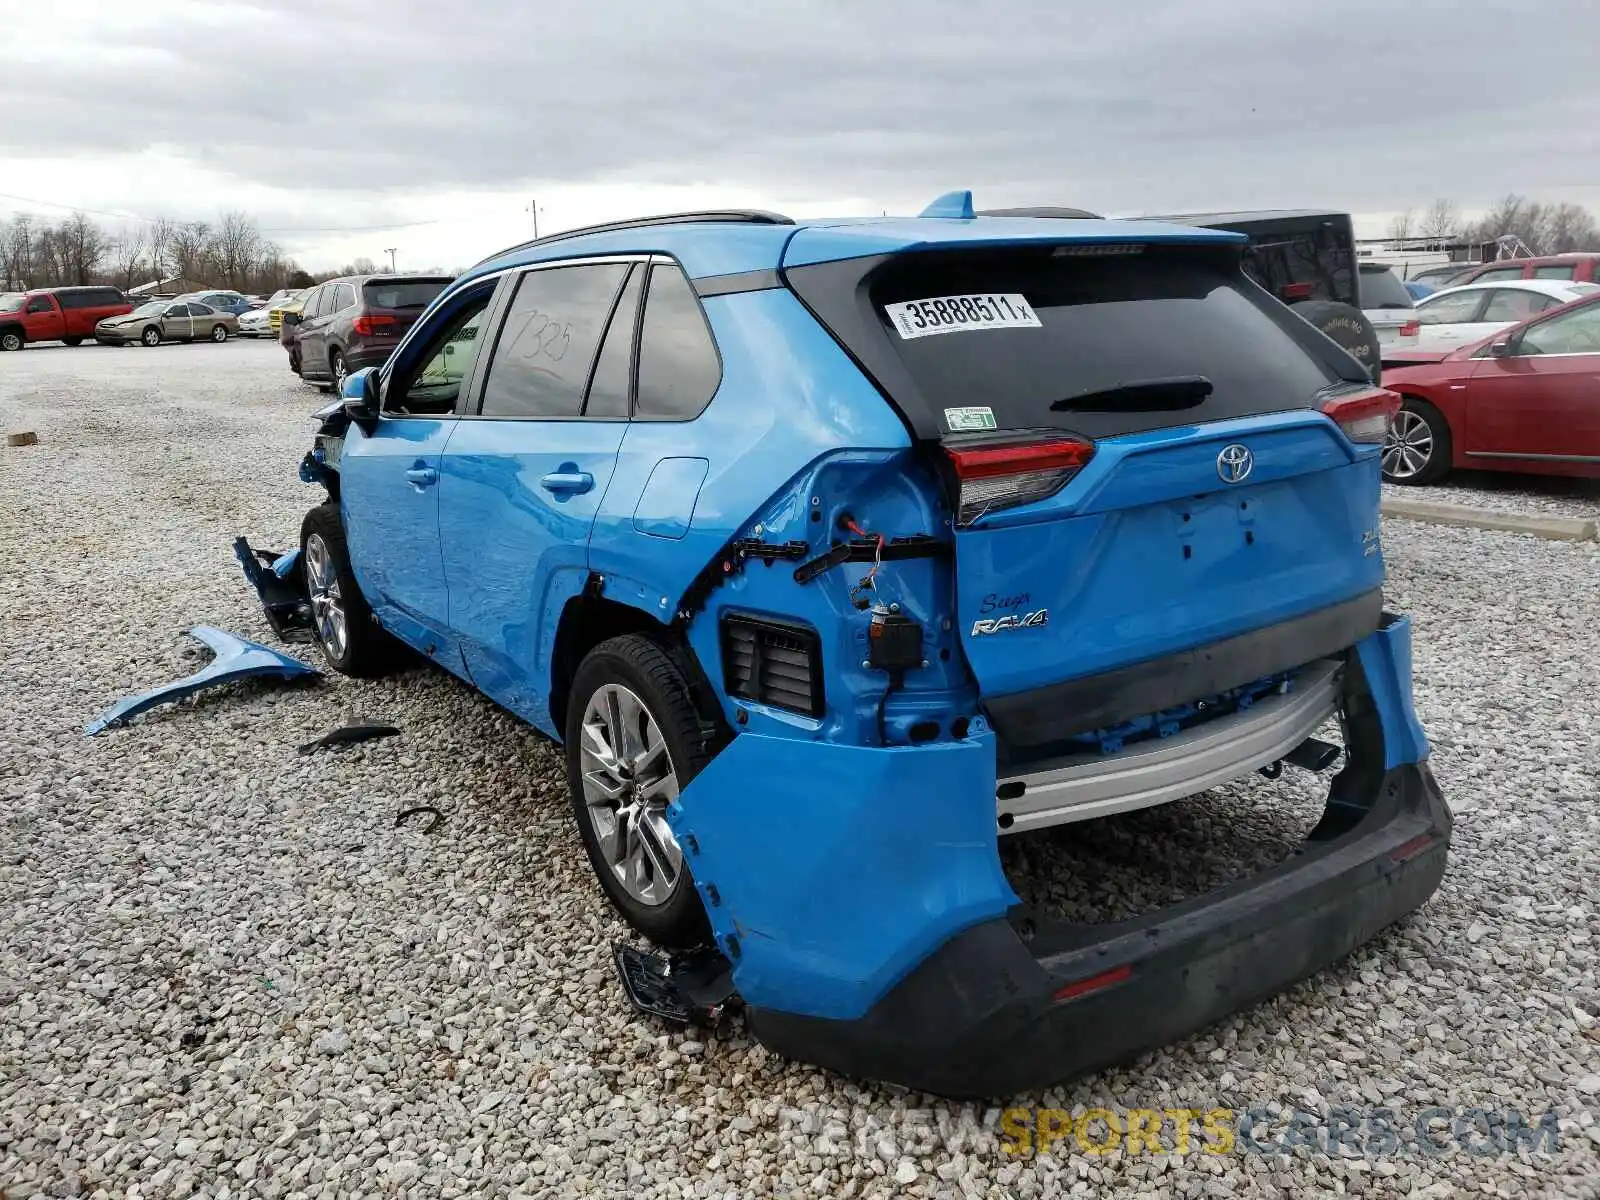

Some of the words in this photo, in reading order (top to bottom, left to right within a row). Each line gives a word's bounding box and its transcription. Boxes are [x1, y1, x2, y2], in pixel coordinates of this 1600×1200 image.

[905, 296, 1019, 329] 35888511
[505, 309, 573, 362] 7325
[971, 608, 1049, 637] RAV4
